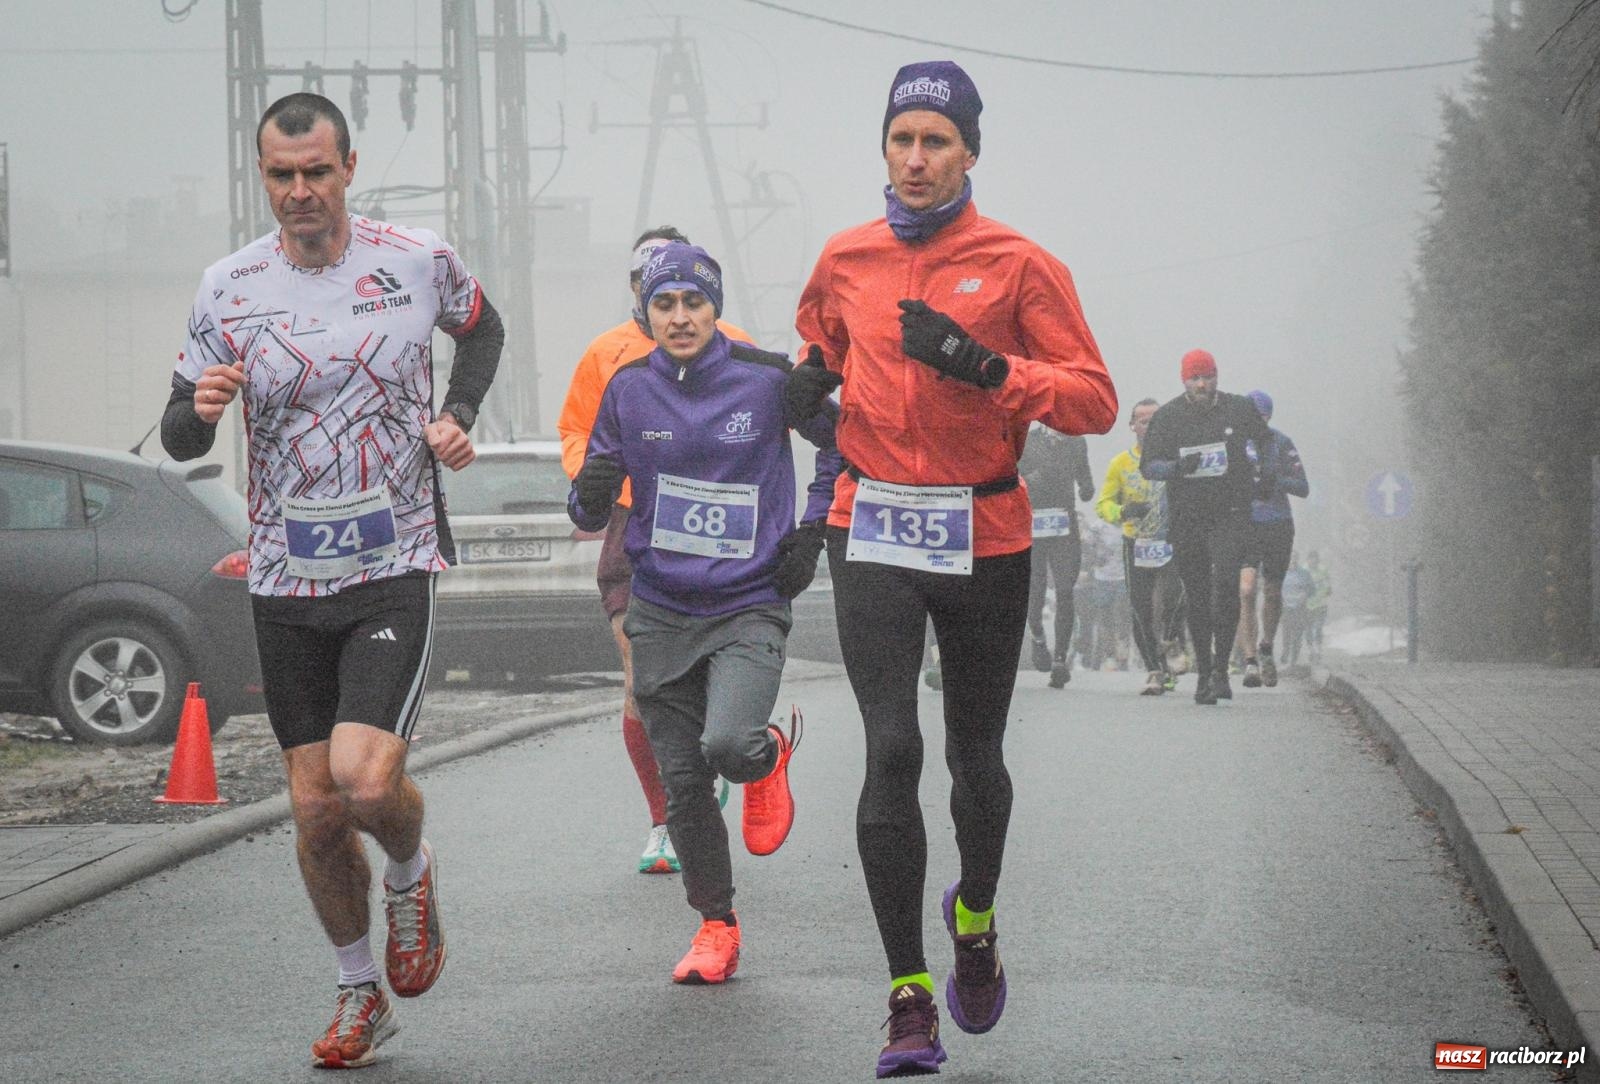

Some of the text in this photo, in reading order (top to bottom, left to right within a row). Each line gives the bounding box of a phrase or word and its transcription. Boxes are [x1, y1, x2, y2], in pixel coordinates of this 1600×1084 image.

[896, 83, 948, 100] SILESIAN
[230, 260, 270, 280] deep
[388, 294, 412, 308] TEAM
[726, 420, 752, 434] Gryf
[683, 504, 726, 536] 68
[876, 508, 949, 548] 135
[312, 520, 364, 556] 24
[472, 544, 491, 558] SK
[1140, 545, 1164, 560] 165
